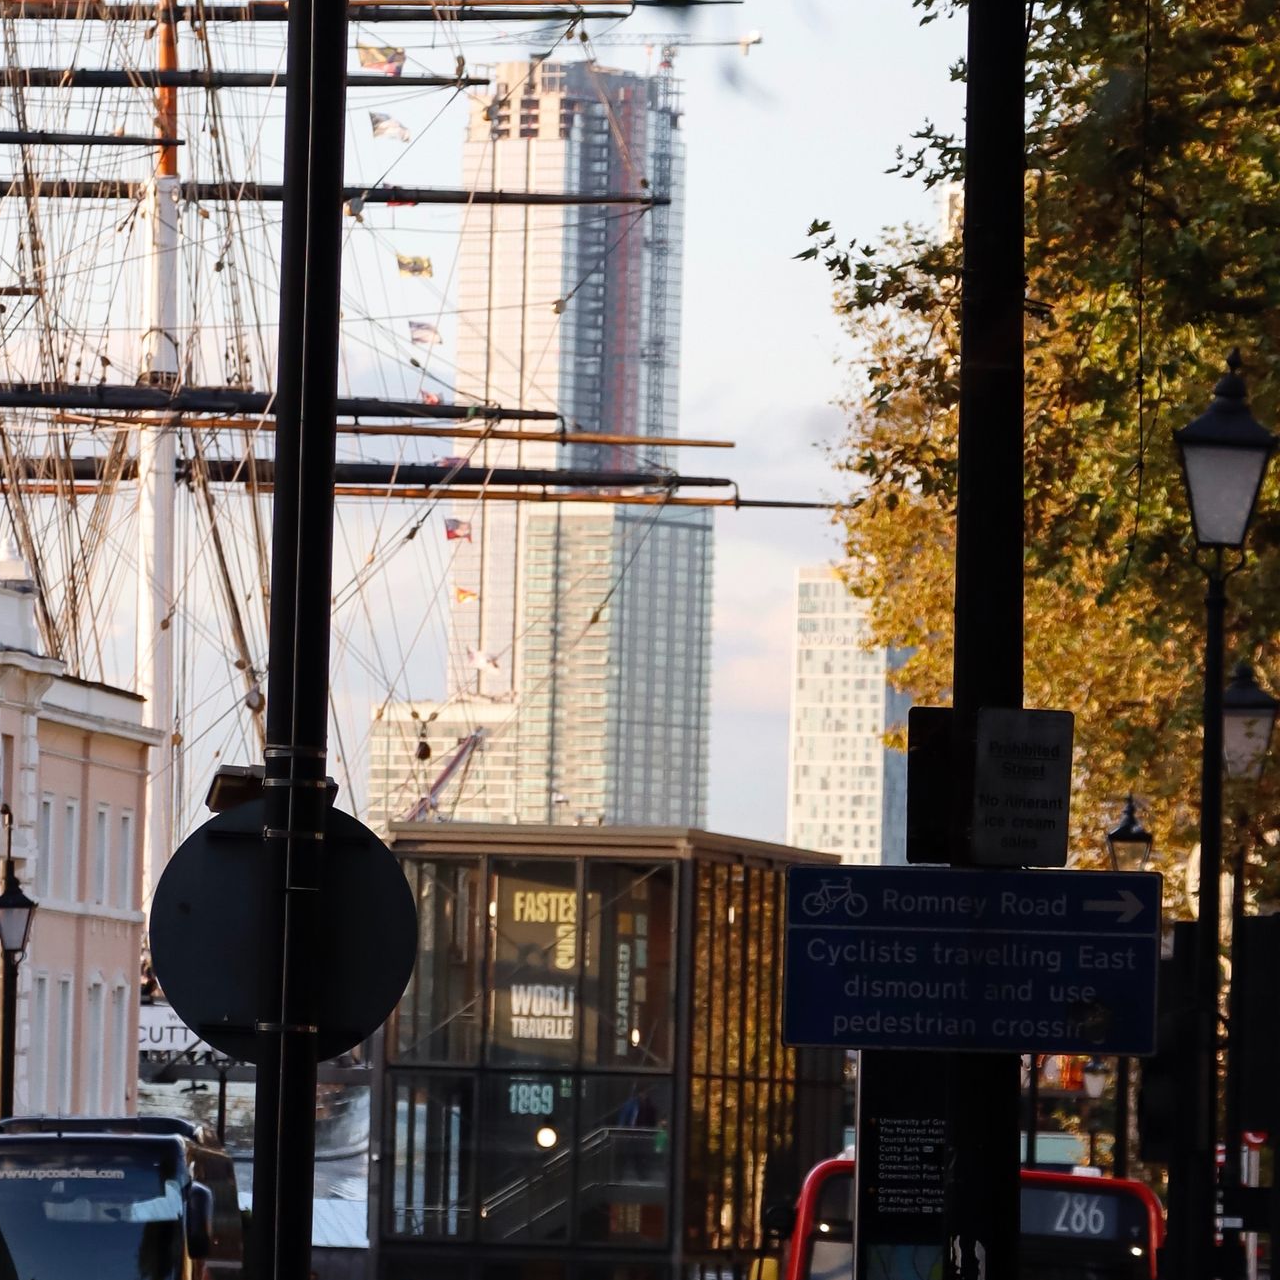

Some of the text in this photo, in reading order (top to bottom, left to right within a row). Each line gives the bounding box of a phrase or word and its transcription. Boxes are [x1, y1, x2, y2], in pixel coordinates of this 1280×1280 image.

[979, 793, 1000, 807] No
[882, 888, 1068, 918] Romney Road
[807, 937, 1137, 973] Cyclists travelling East
[511, 985, 575, 1017] WORL
[844, 974, 1097, 1004] dismount and use
[833, 1010, 977, 1037] pedestrian
[508, 1084, 554, 1115] 1869
[1054, 1190, 1105, 1234] 286
